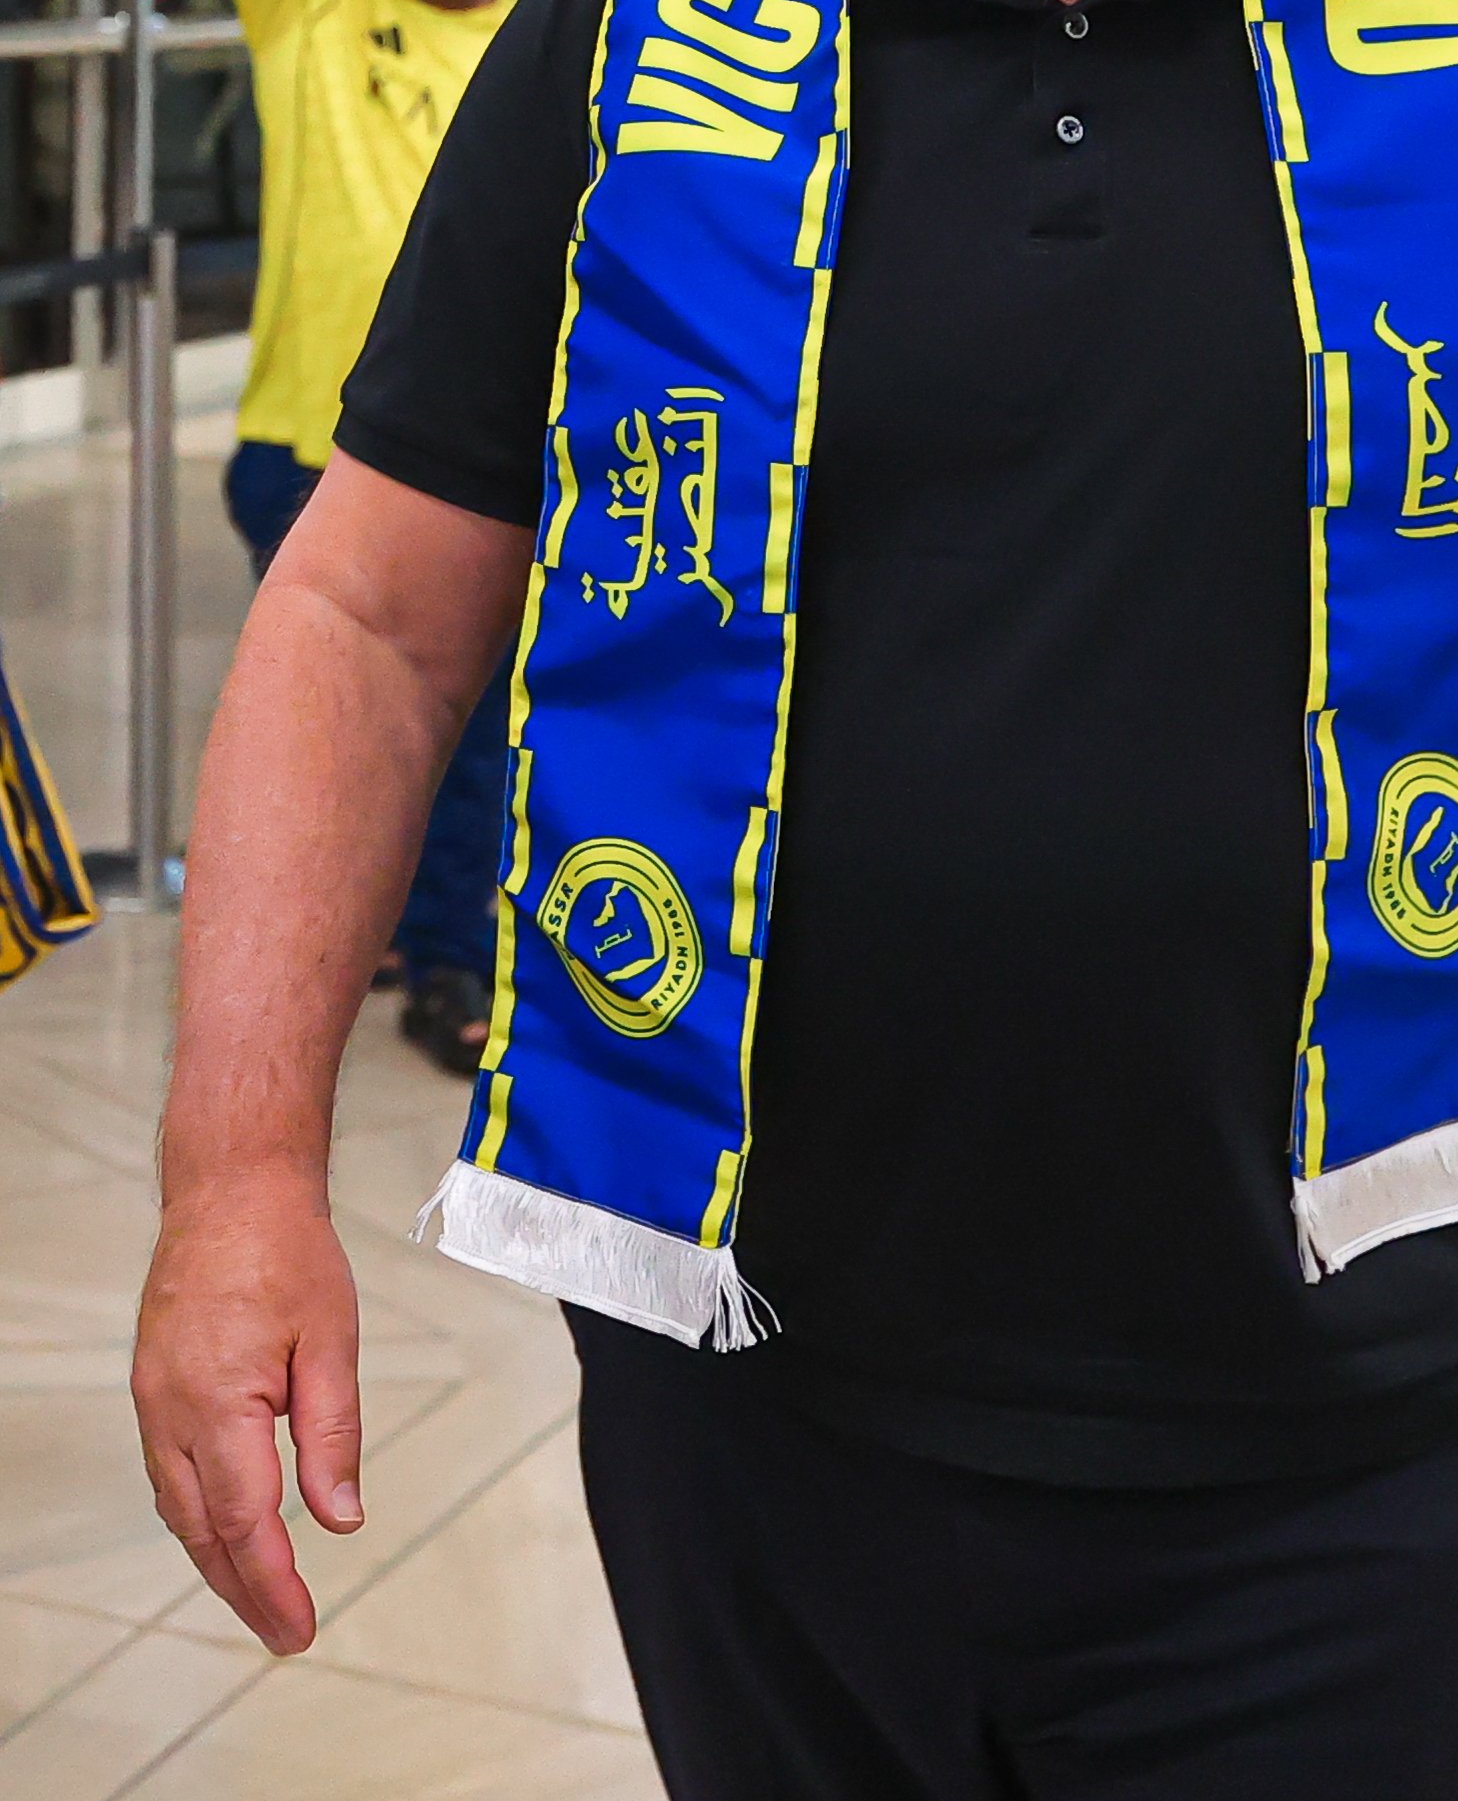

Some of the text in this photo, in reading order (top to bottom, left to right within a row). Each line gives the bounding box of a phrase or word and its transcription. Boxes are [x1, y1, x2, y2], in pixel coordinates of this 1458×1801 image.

[580, 406, 668, 621] عقلية
[656, 386, 735, 629] النصر
[650, 945, 689, 1011] RIYADH
